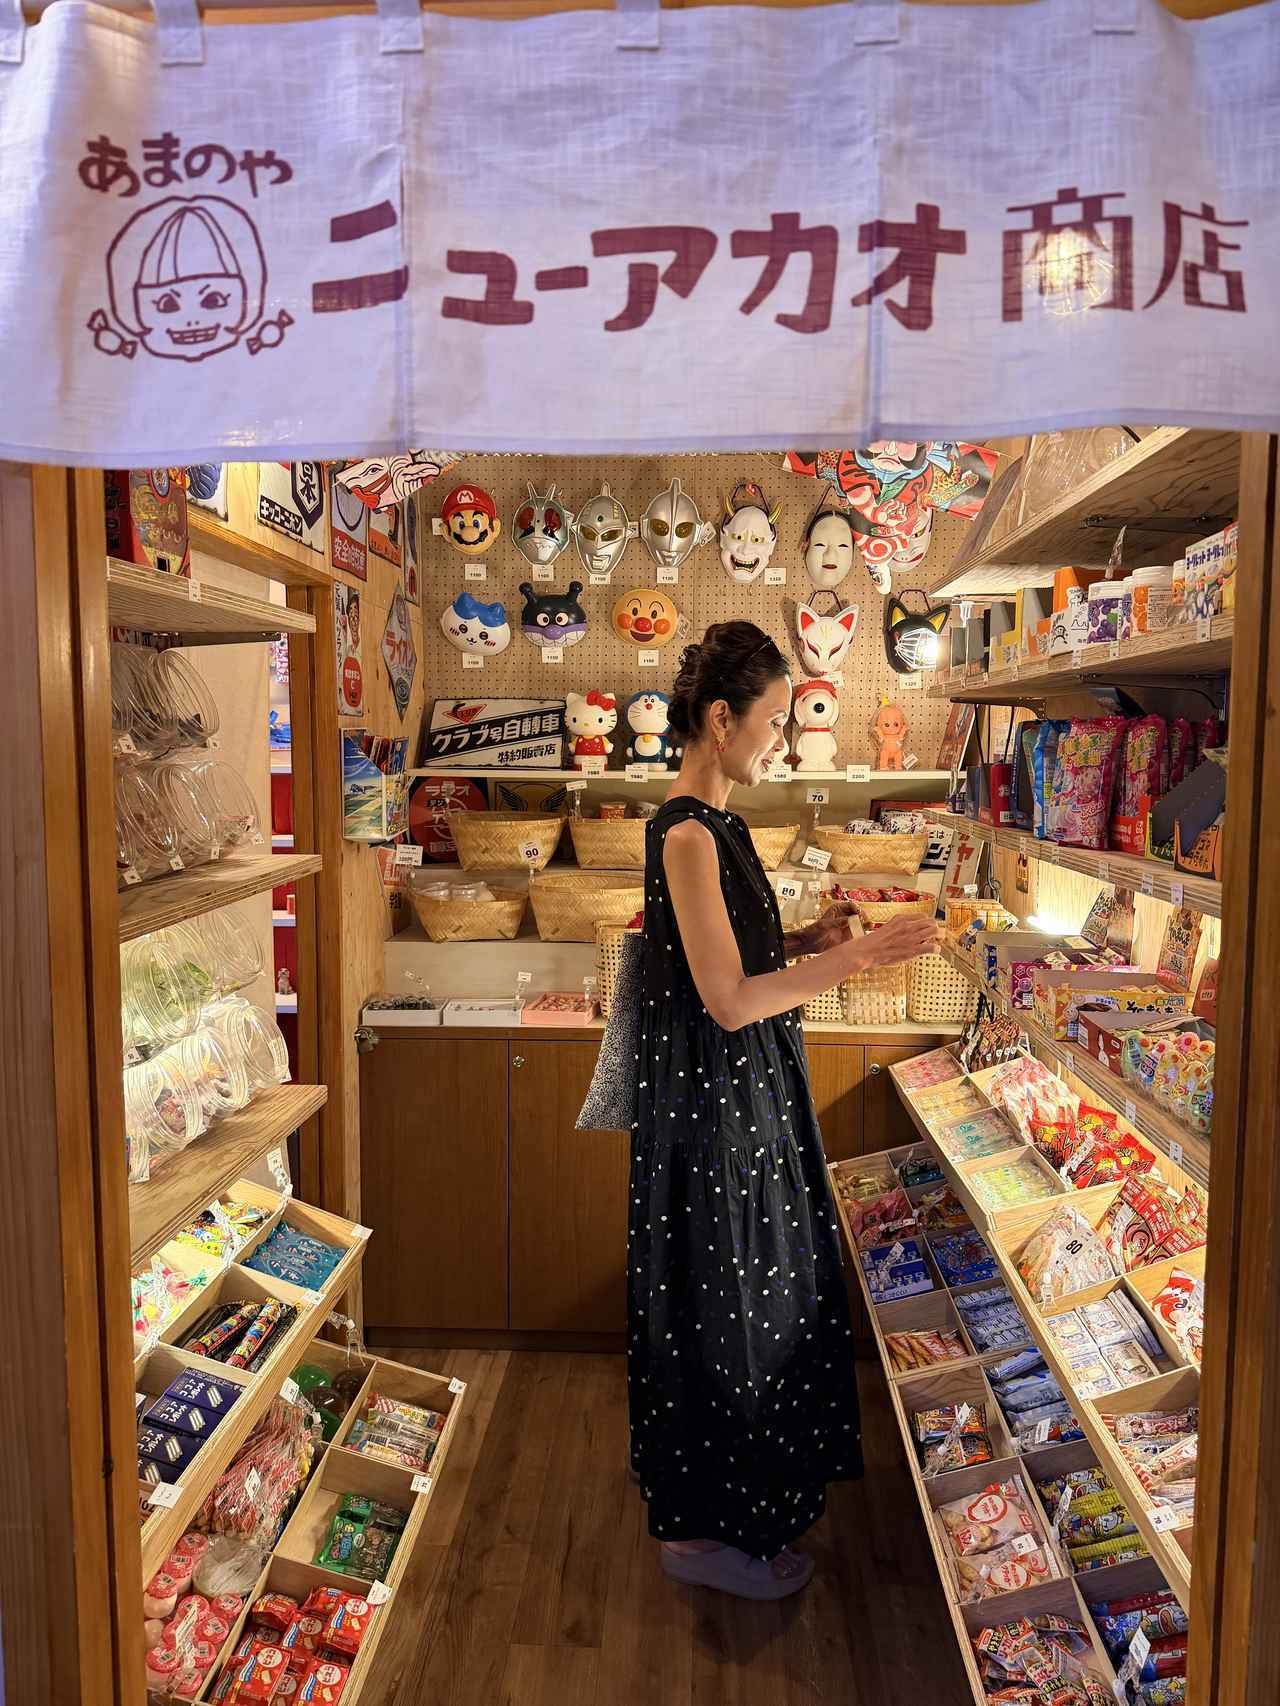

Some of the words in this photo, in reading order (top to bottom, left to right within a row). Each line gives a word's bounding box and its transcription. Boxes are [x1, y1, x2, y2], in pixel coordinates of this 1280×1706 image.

[79, 135, 292, 198] あまのや
[312, 187, 1250, 333] ニューアカオ商店
[525, 848, 540, 859] 90
[781, 887, 796, 897] 80
[1065, 1239, 1084, 1256] 80
